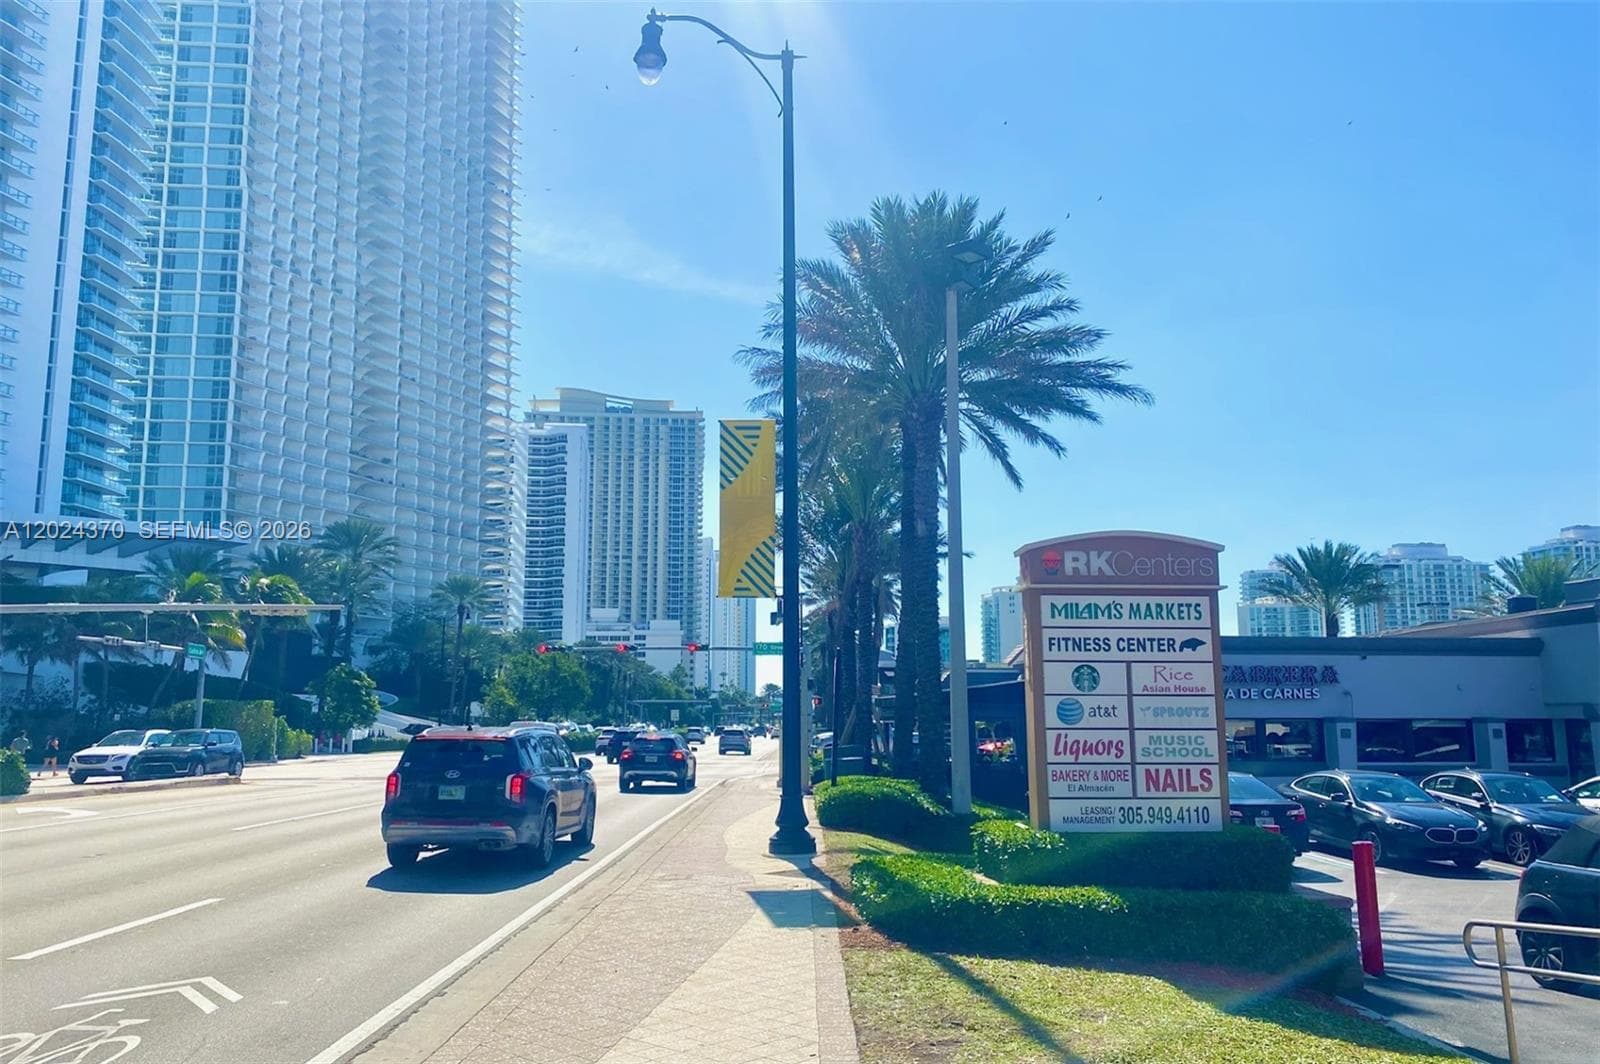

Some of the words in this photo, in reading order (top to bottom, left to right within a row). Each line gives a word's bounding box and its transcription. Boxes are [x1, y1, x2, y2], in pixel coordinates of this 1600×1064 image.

[1050, 600, 1123, 620] MILAM'S
[1128, 602, 1203, 620] MARKETS
[1048, 636, 1112, 652] FITNESS
[1116, 637, 1177, 653] CENTER
[1153, 665, 1194, 683] Rice
[1142, 684, 1171, 693] Asian
[1174, 685, 1207, 693] House
[1241, 688, 1259, 699] DE
[1263, 688, 1320, 699] CARNES
[1088, 704, 1118, 718] at&t
[1152, 706, 1210, 718] SPROUTZ
[1148, 735, 1205, 746] MUSIC
[1053, 733, 1125, 762] Liquors
[1141, 747, 1214, 758] SCHOOL
[1051, 769, 1090, 782] BAKERY
[1093, 771, 1099, 782] &
[1101, 770, 1130, 782] MORE
[1144, 767, 1214, 793] NAILS
[1068, 784, 1077, 793] El
[1080, 806, 1116, 816] LEASING/
[1118, 806, 1210, 825] 305.949.4110
[1062, 815, 1116, 825] MANAGEMENT
